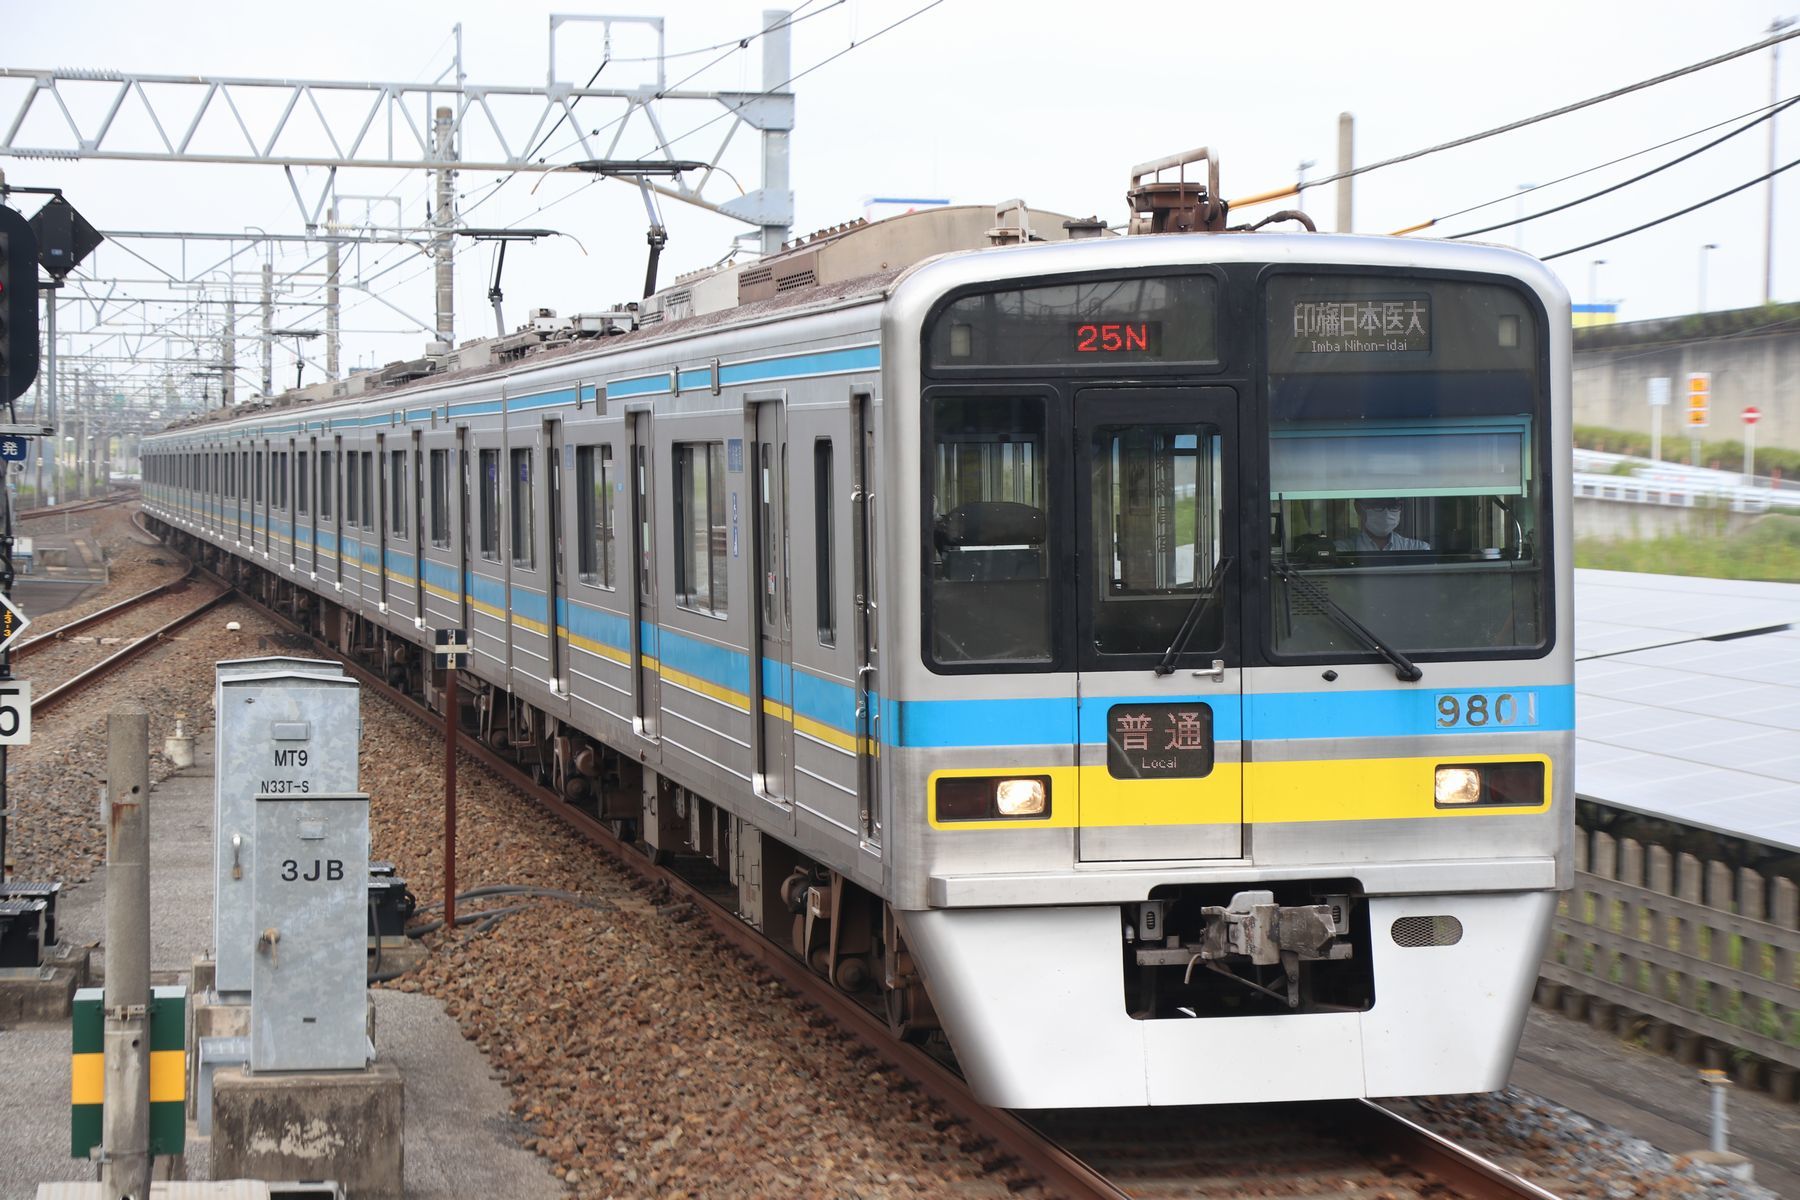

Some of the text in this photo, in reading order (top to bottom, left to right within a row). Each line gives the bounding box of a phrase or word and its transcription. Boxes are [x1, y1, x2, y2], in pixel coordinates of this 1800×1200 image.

[1294, 301, 1426, 338] 印旛日本医大
[1077, 324, 1147, 352] 25N
[1311, 339, 1408, 353] Imba Nihon-idai
[1437, 692, 1537, 727] 9801
[1116, 712, 1202, 751] 普通
[274, 749, 308, 767] MT9
[1142, 756, 1177, 769] Local
[261, 780, 309, 793] N33T-S
[281, 859, 344, 882] 3JB
